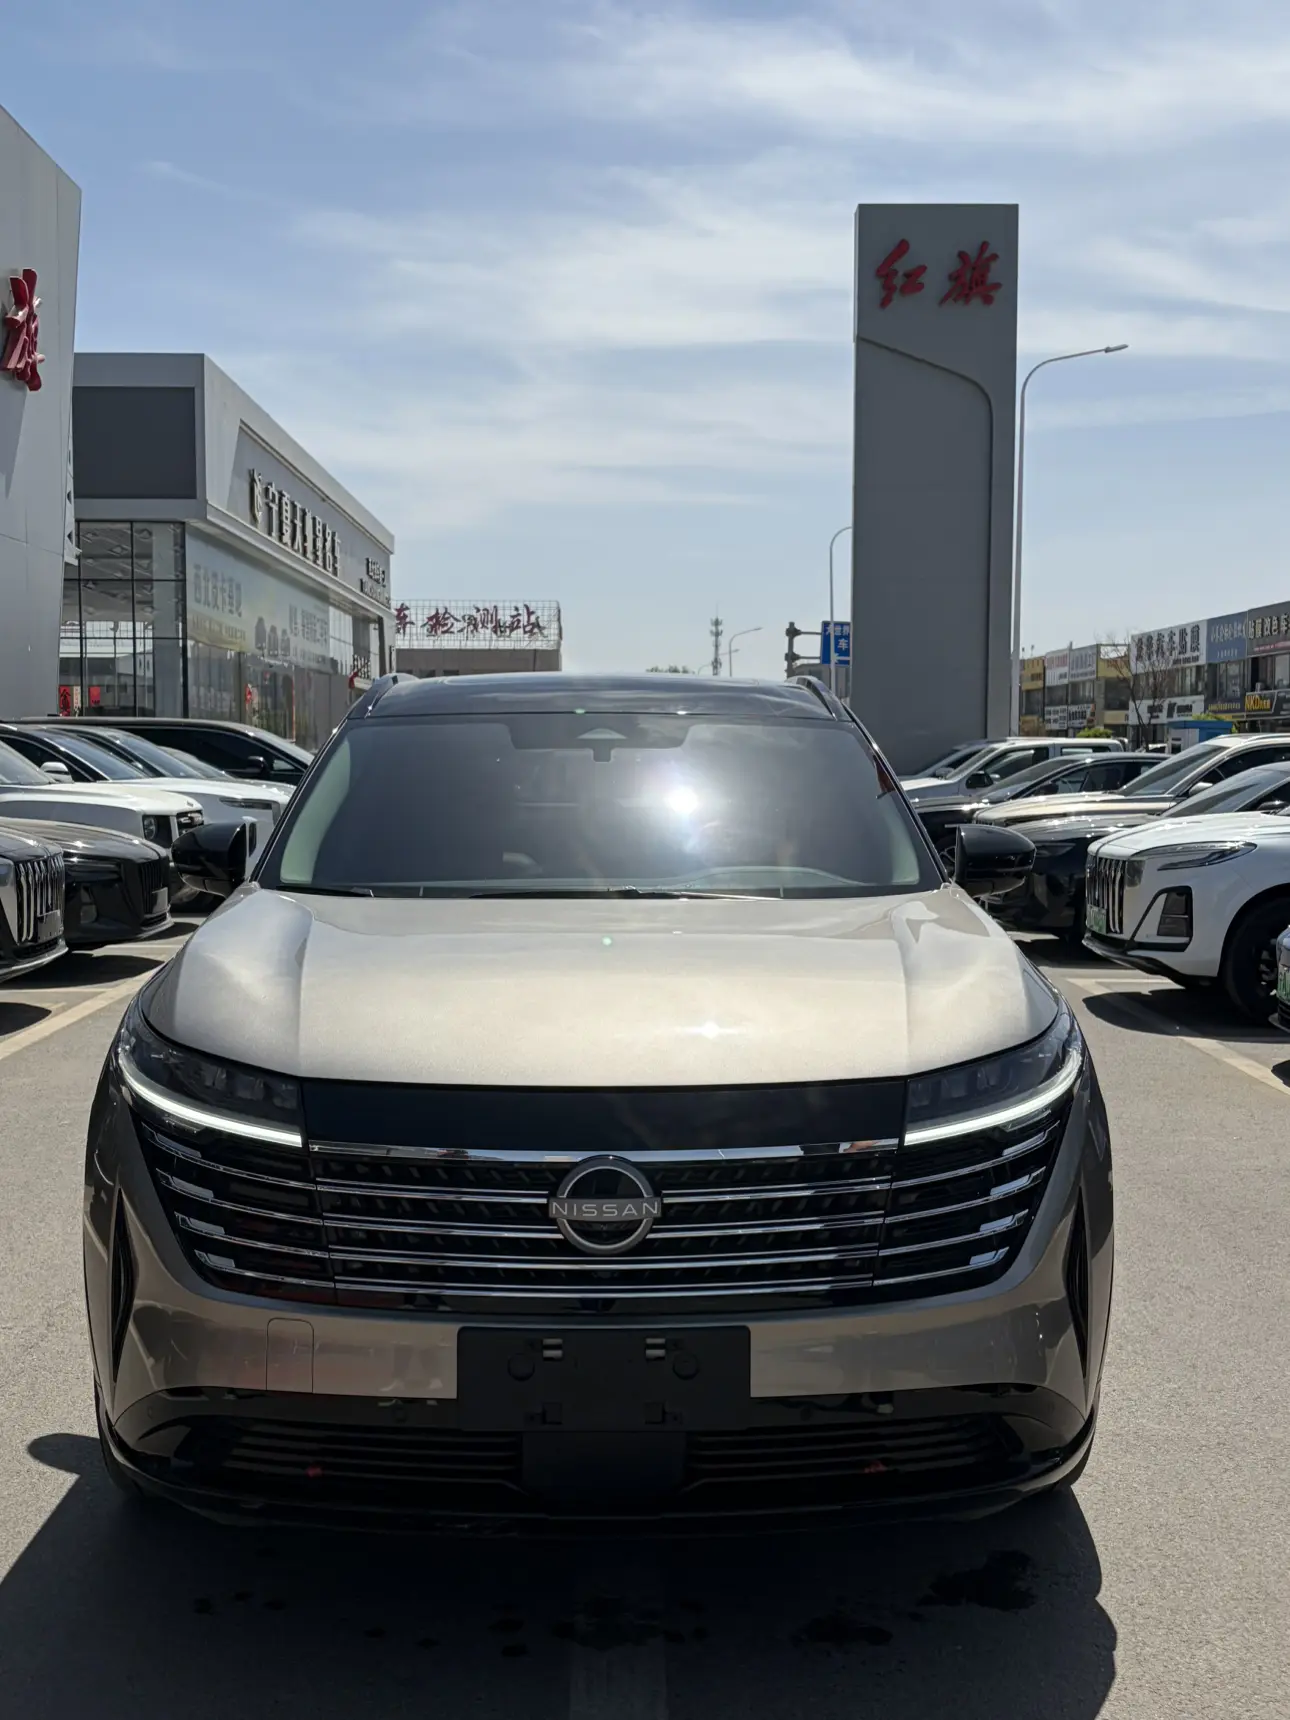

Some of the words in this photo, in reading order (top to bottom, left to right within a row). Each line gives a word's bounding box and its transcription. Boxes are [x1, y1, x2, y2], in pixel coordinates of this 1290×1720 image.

[875, 239, 1003, 309] 红旗
[265, 482, 342, 577] 宁夏天星名车
[552, 1201, 658, 1217] NISSAN
